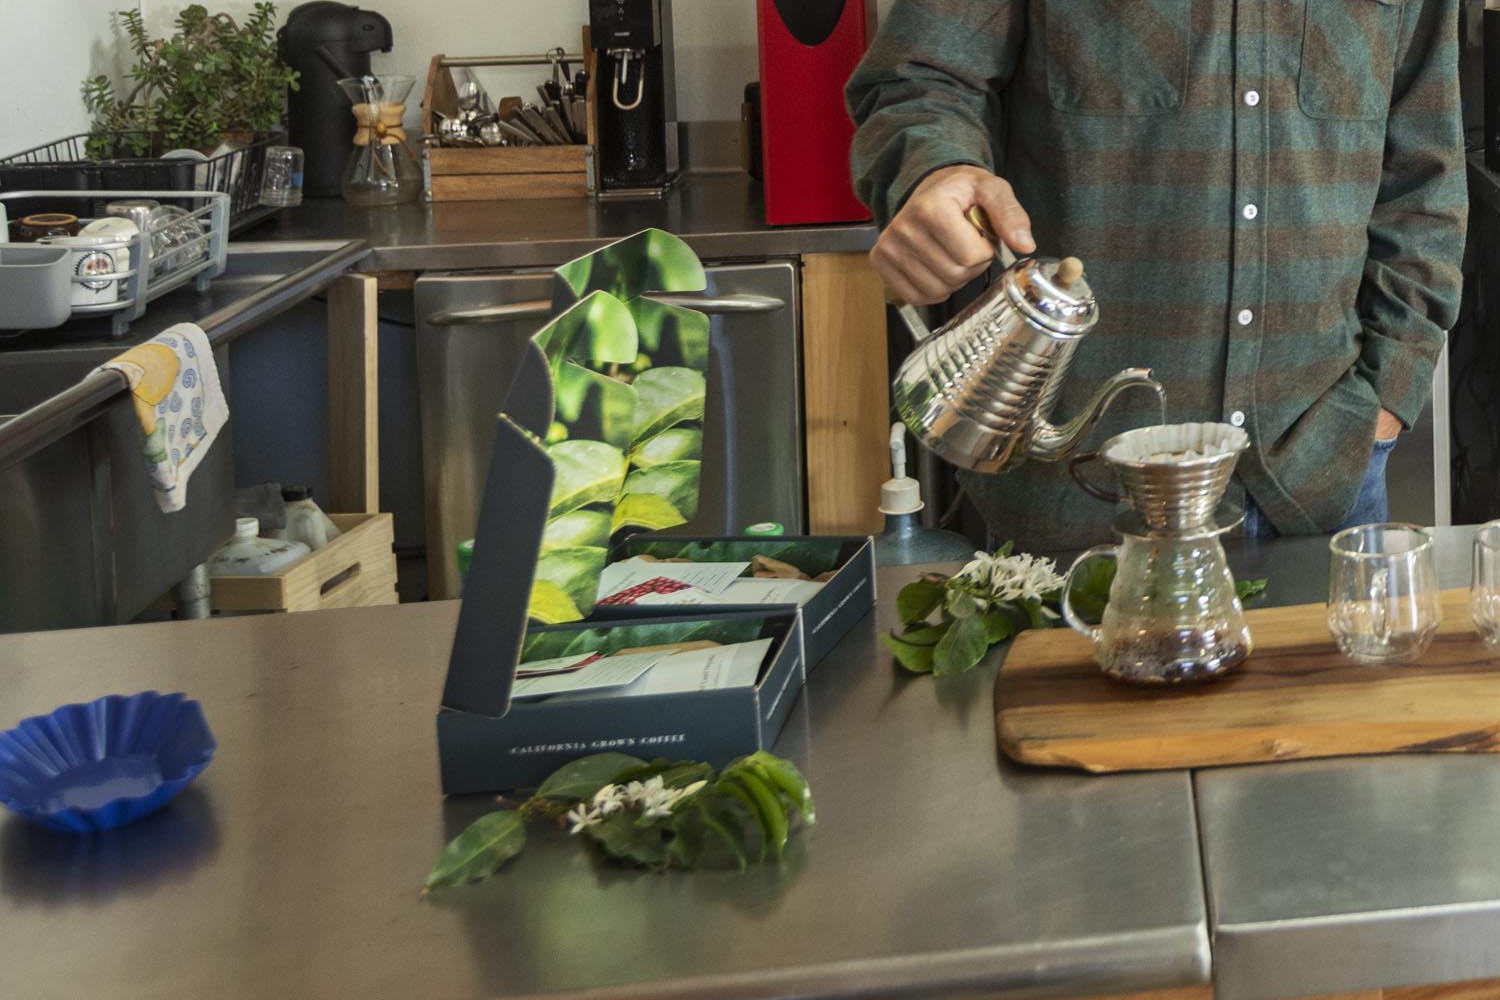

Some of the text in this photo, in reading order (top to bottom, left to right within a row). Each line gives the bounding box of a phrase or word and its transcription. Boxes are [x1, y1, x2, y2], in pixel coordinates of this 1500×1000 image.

[511, 733, 686, 754] CALIFORNIA GROWN COFFEE
